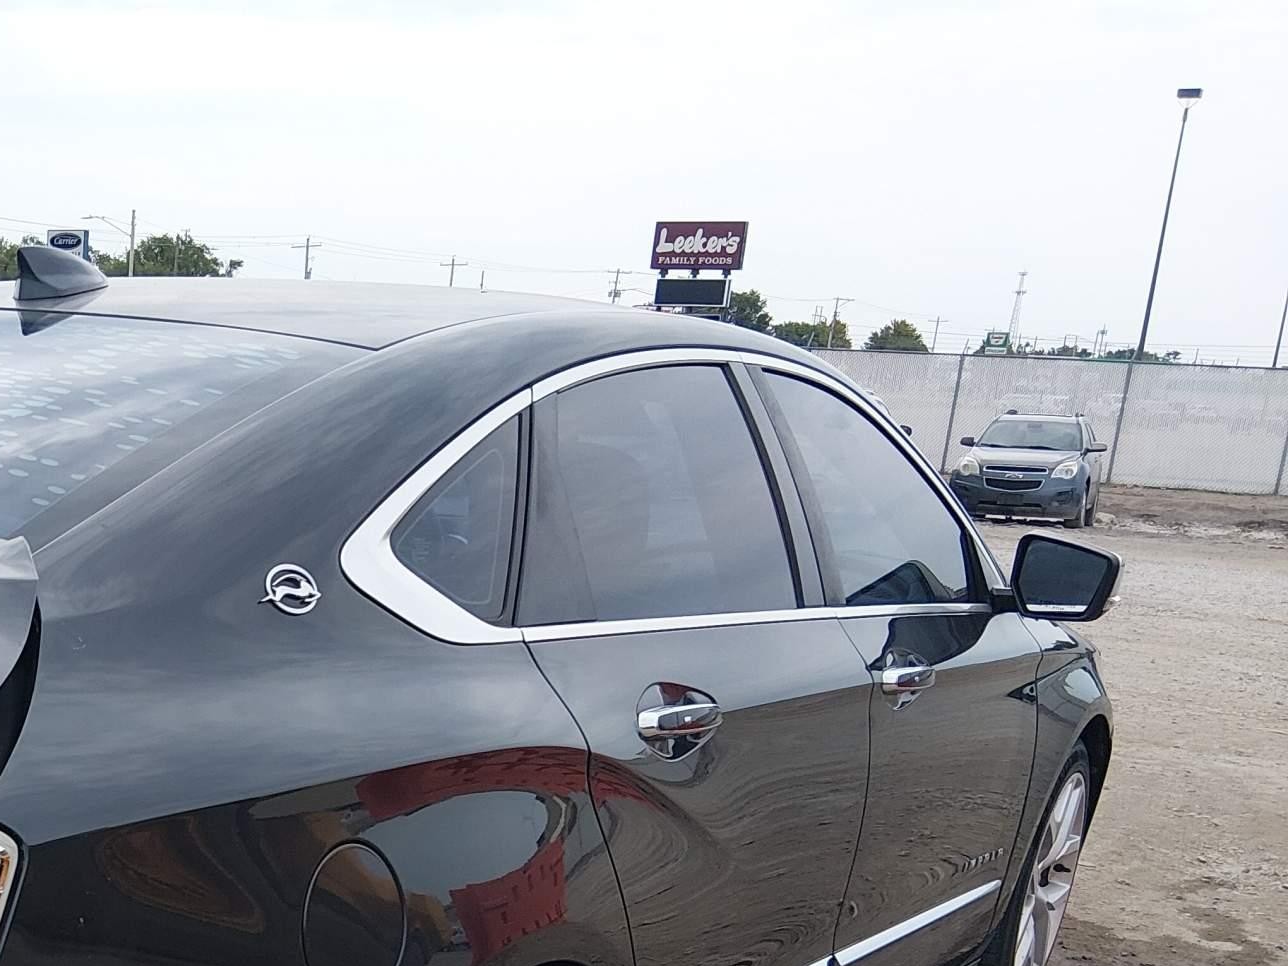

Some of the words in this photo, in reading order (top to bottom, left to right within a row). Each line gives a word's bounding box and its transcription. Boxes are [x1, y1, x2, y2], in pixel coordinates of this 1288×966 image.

[54, 236, 80, 245] Carrier
[655, 227, 740, 253] Leeker's
[658, 256, 695, 264] FAMILY
